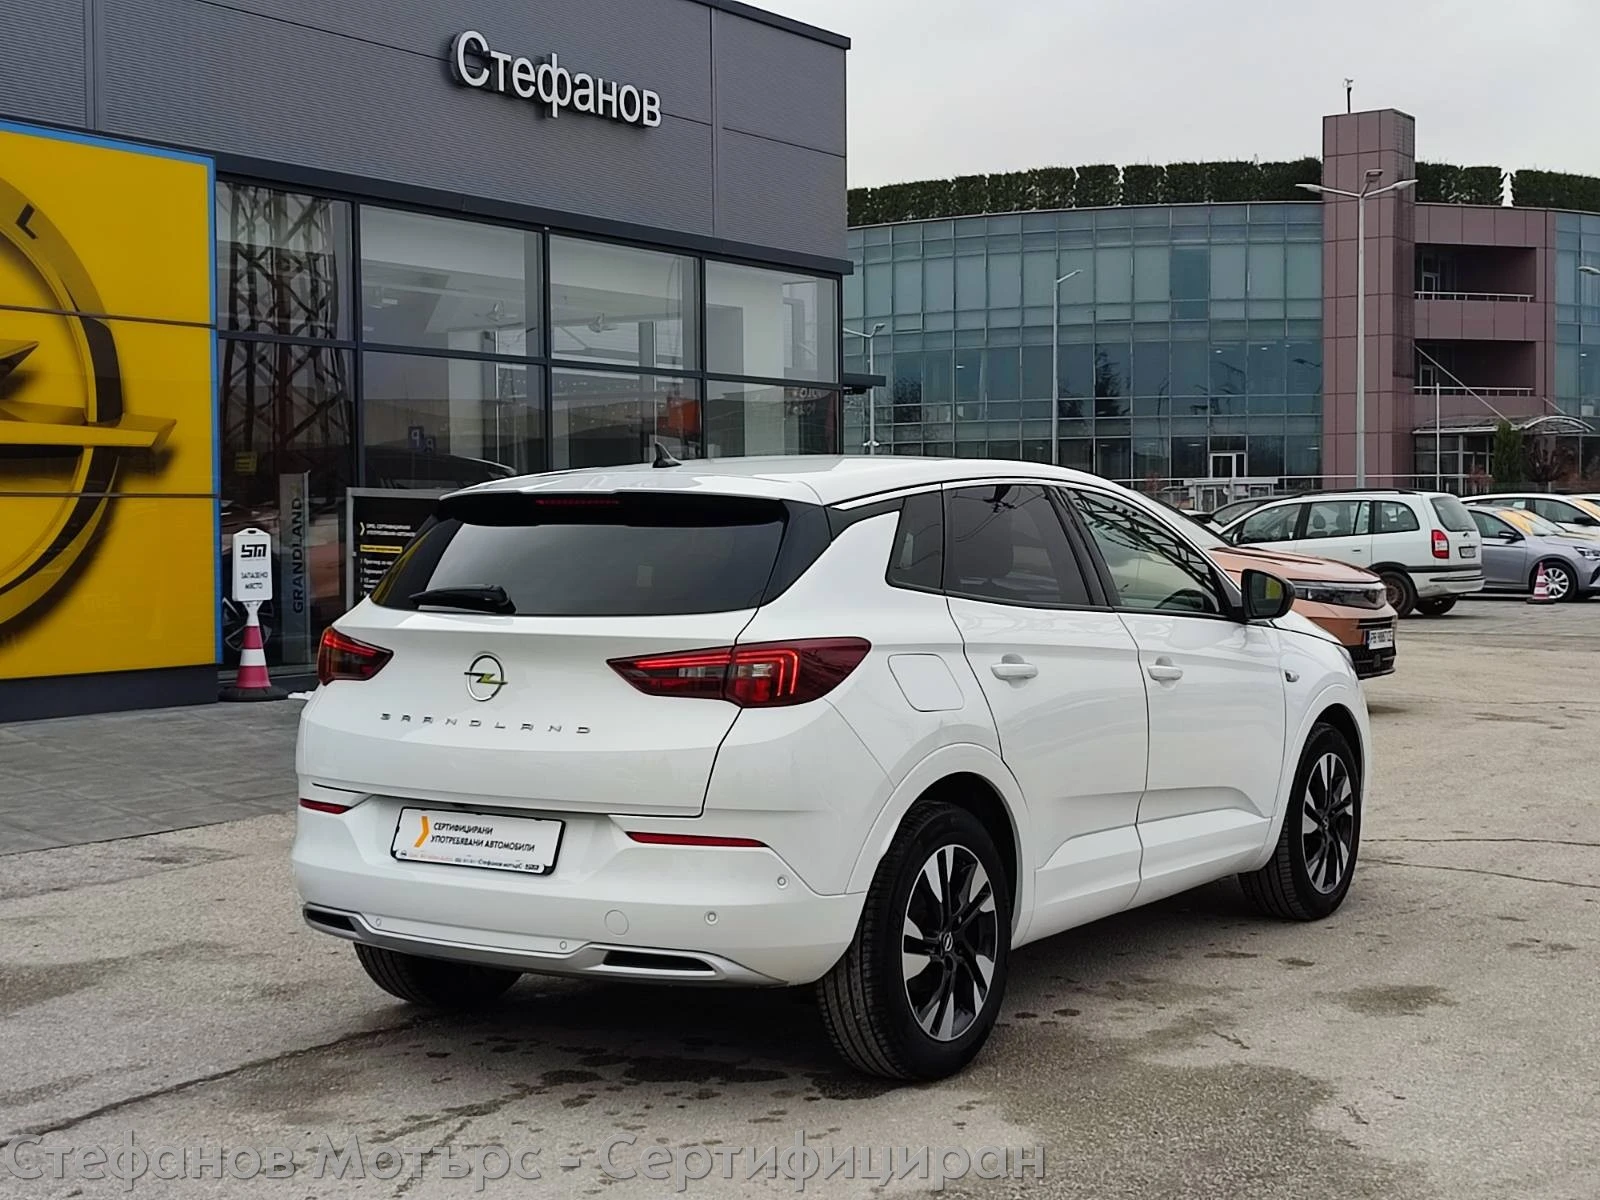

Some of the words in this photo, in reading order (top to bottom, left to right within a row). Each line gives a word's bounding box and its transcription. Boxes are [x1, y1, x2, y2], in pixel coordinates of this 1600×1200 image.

[456, 30, 662, 128] Стефанов
[291, 498, 304, 614] GRANDLAND
[379, 712, 592, 735] GRANDLAND
[433, 822, 493, 835] СЕРТИФИЦИРАНИ
[430, 835, 484, 847] УПОТРЕБЯВАНИ
[484, 840, 536, 852] АВТОМОБИЛИ
